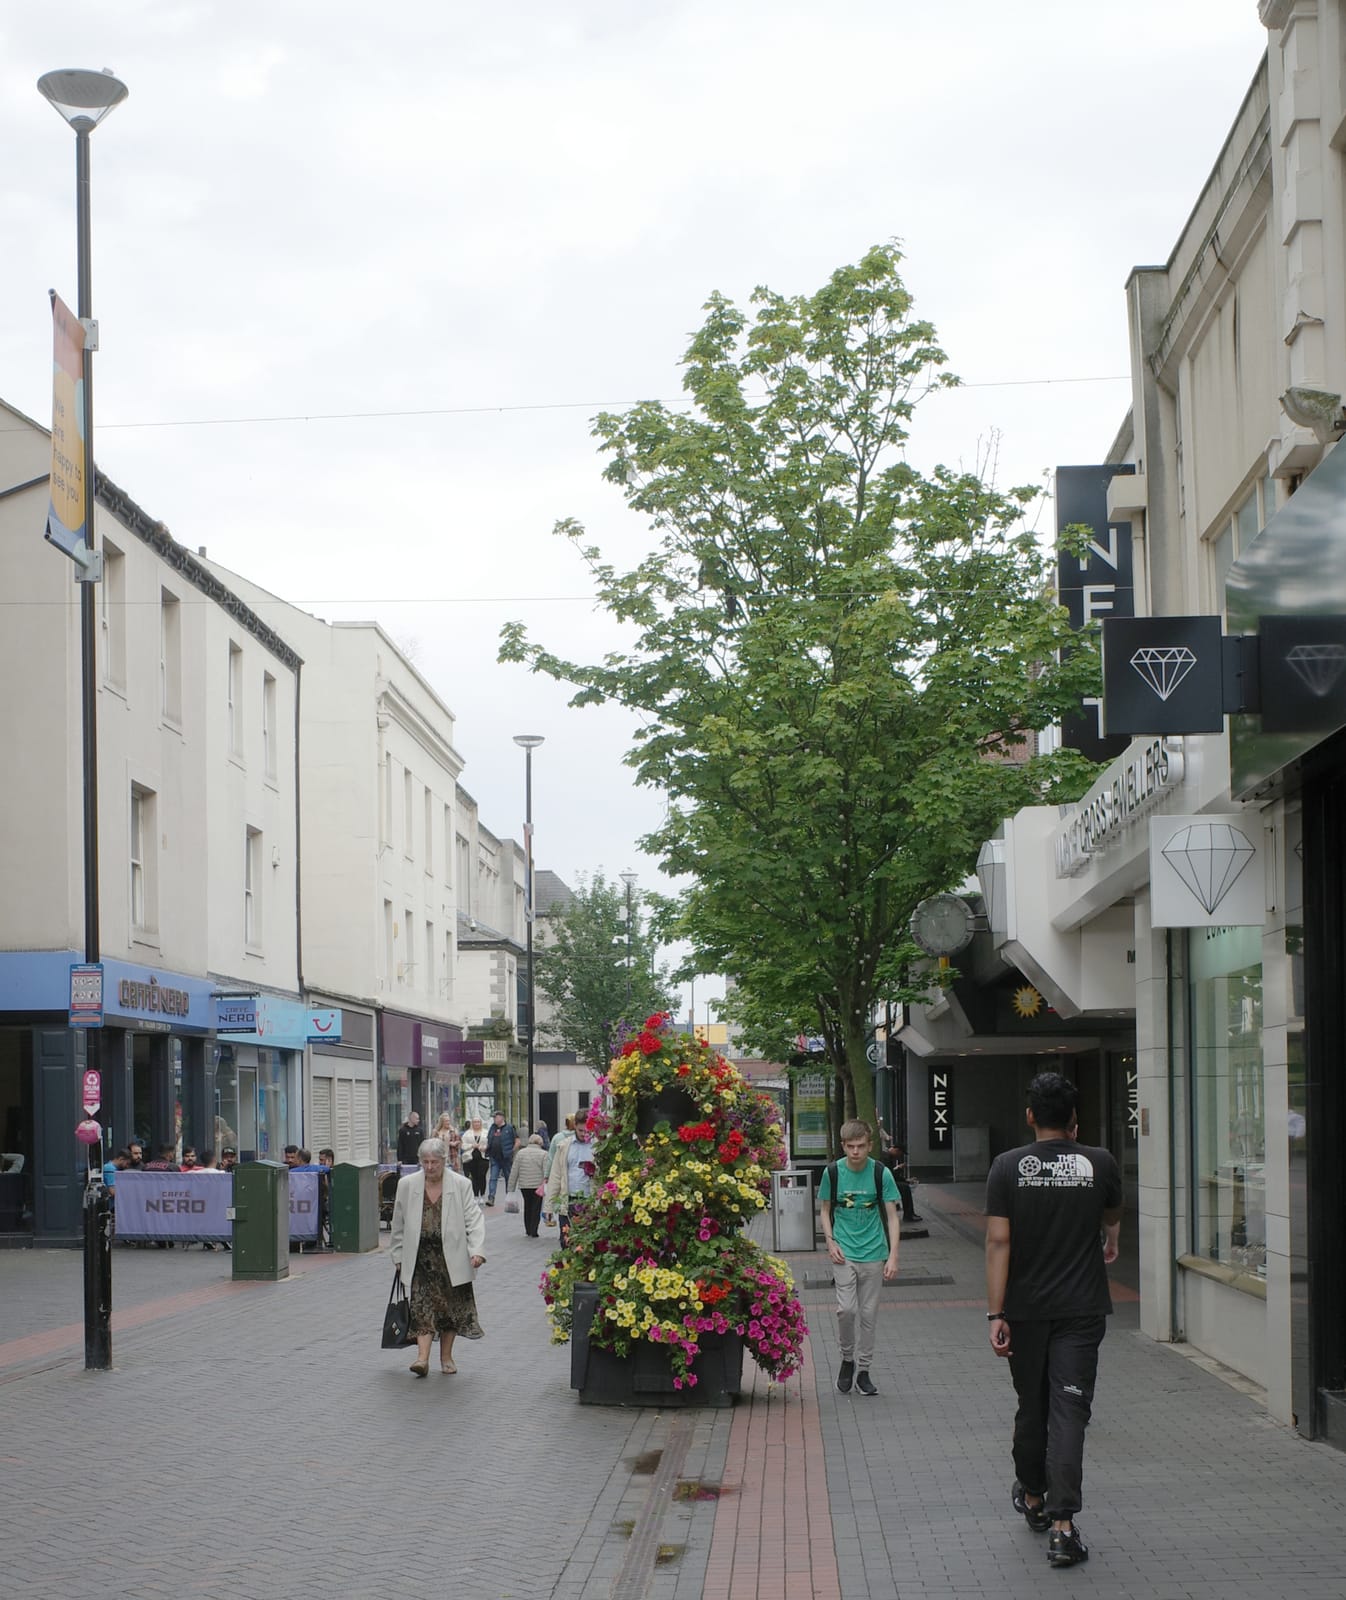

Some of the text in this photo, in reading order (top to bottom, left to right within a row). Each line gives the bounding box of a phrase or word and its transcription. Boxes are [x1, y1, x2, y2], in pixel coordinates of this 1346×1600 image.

[54, 393, 65, 417] We
[53, 423, 65, 442] are
[53, 442, 82, 481] happy to
[52, 472, 80, 503] see you
[1079, 528, 1117, 739] NET
[1109, 735, 1184, 830] EWELLERS
[218, 1014, 255, 1023] NERO
[933, 1073, 948, 1142] NEXT
[1042, 1161, 1077, 1170] NORTH
[1057, 1154, 1077, 1163] THE
[1052, 1168, 1077, 1177] FACE
[145, 1200, 206, 1214] NERO
